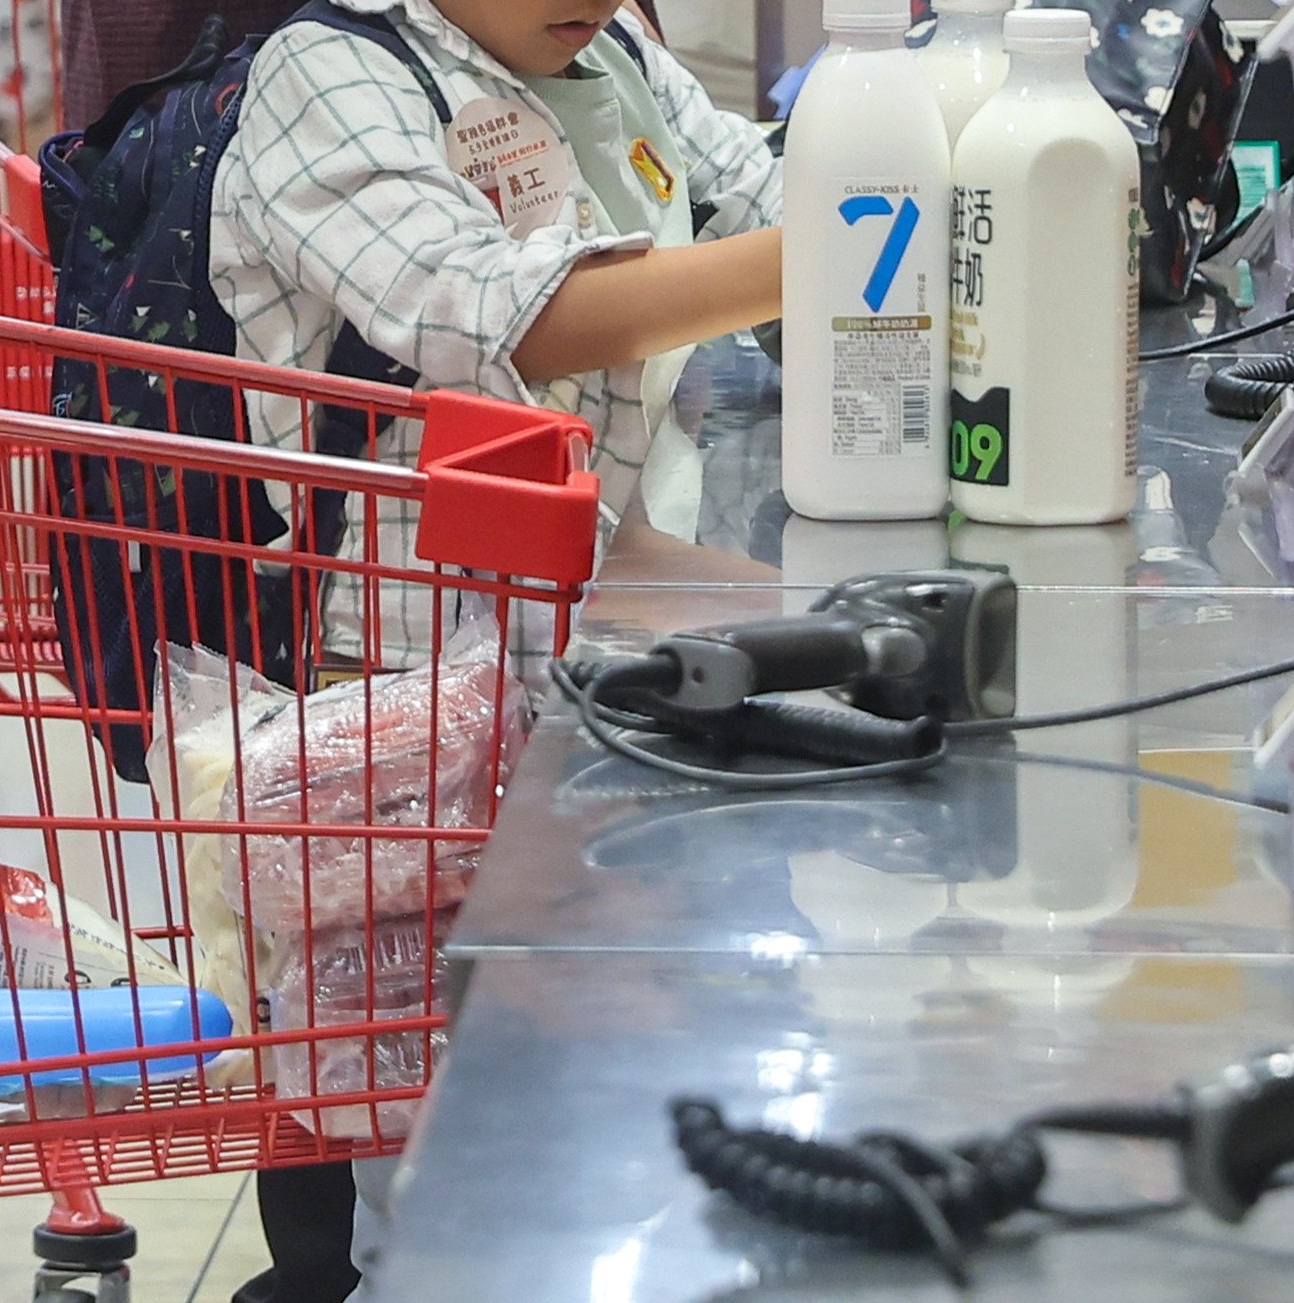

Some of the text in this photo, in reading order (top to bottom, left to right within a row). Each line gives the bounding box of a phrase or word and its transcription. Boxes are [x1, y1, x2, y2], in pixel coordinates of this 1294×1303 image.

[506, 167, 546, 198] 義工
[509, 190, 559, 214] Volunteer
[838, 195, 921, 314] 7
